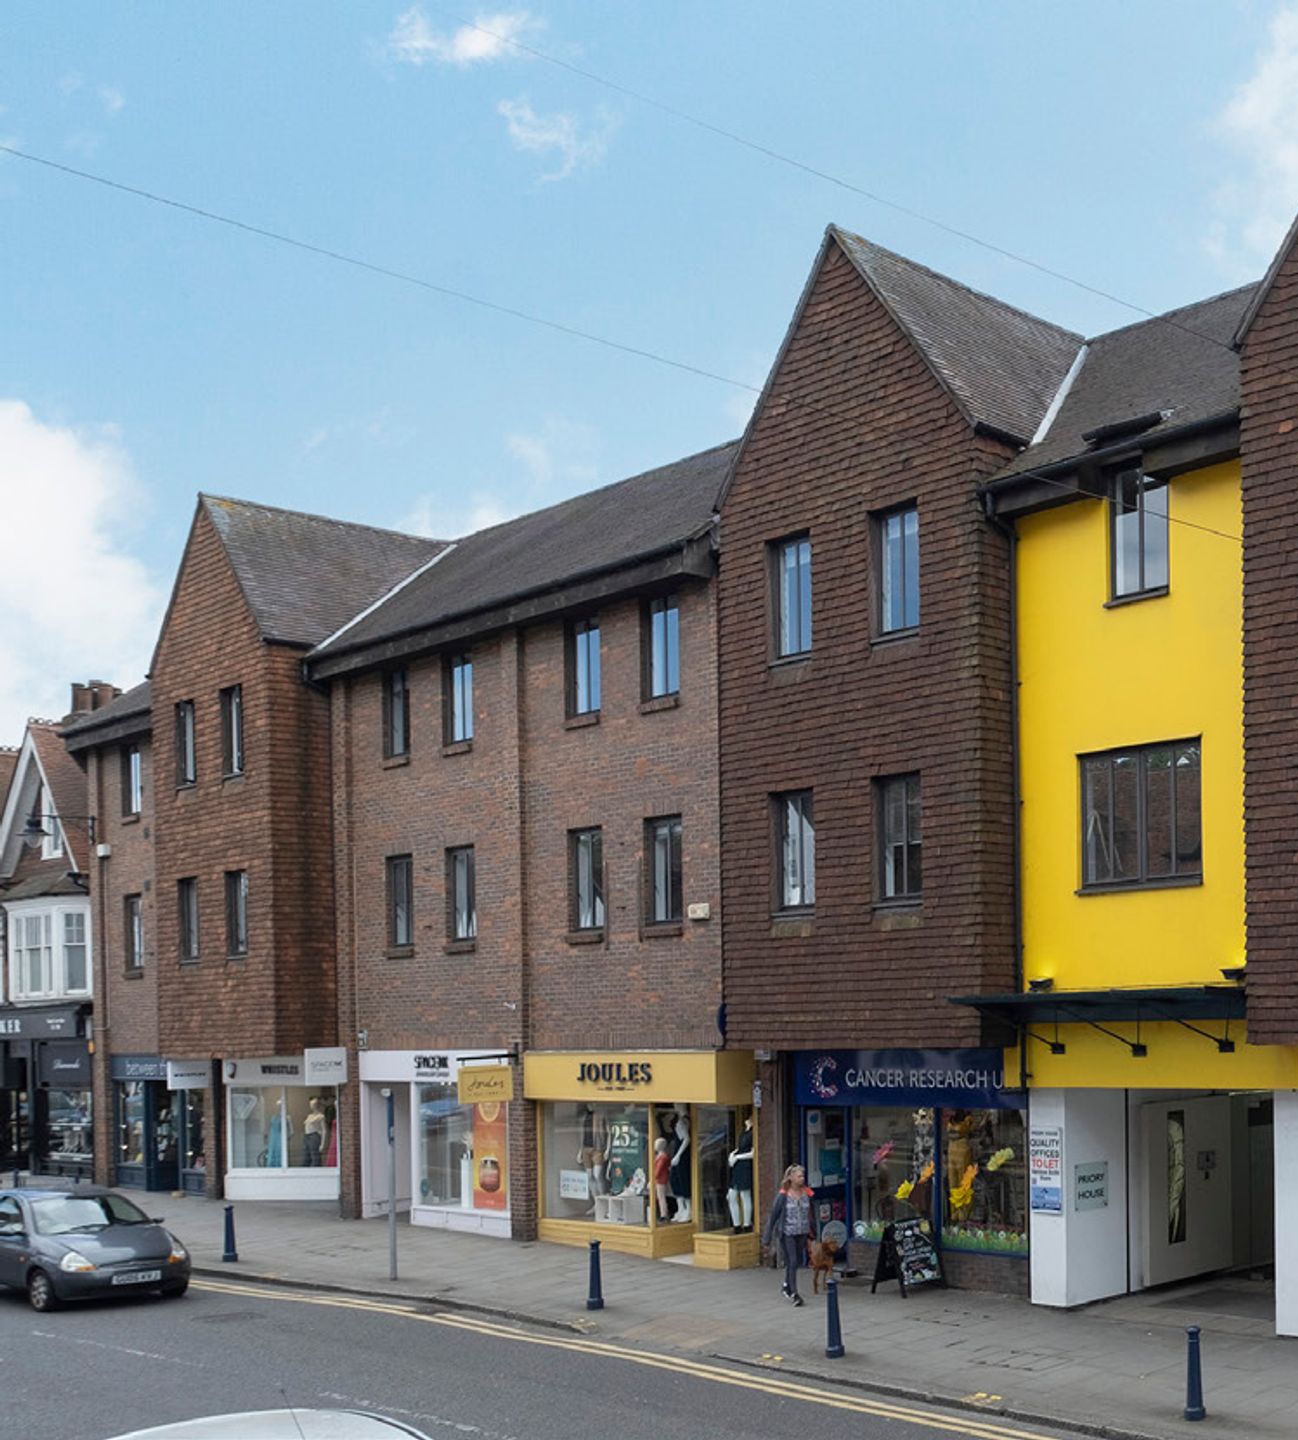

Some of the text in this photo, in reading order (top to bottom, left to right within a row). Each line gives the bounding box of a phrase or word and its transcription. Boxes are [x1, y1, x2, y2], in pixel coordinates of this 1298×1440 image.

[577, 1062, 653, 1084] JOULES
[845, 1069, 1004, 1090] CANCER RESEARCH U
[1030, 1139, 1059, 1148] QUALITY
[1031, 1149, 1060, 1158] OFFICES
[1032, 1159, 1059, 1169] TO LET
[1078, 1173, 1104, 1184] PRIORY
[1078, 1187, 1104, 1200] HOUSE
